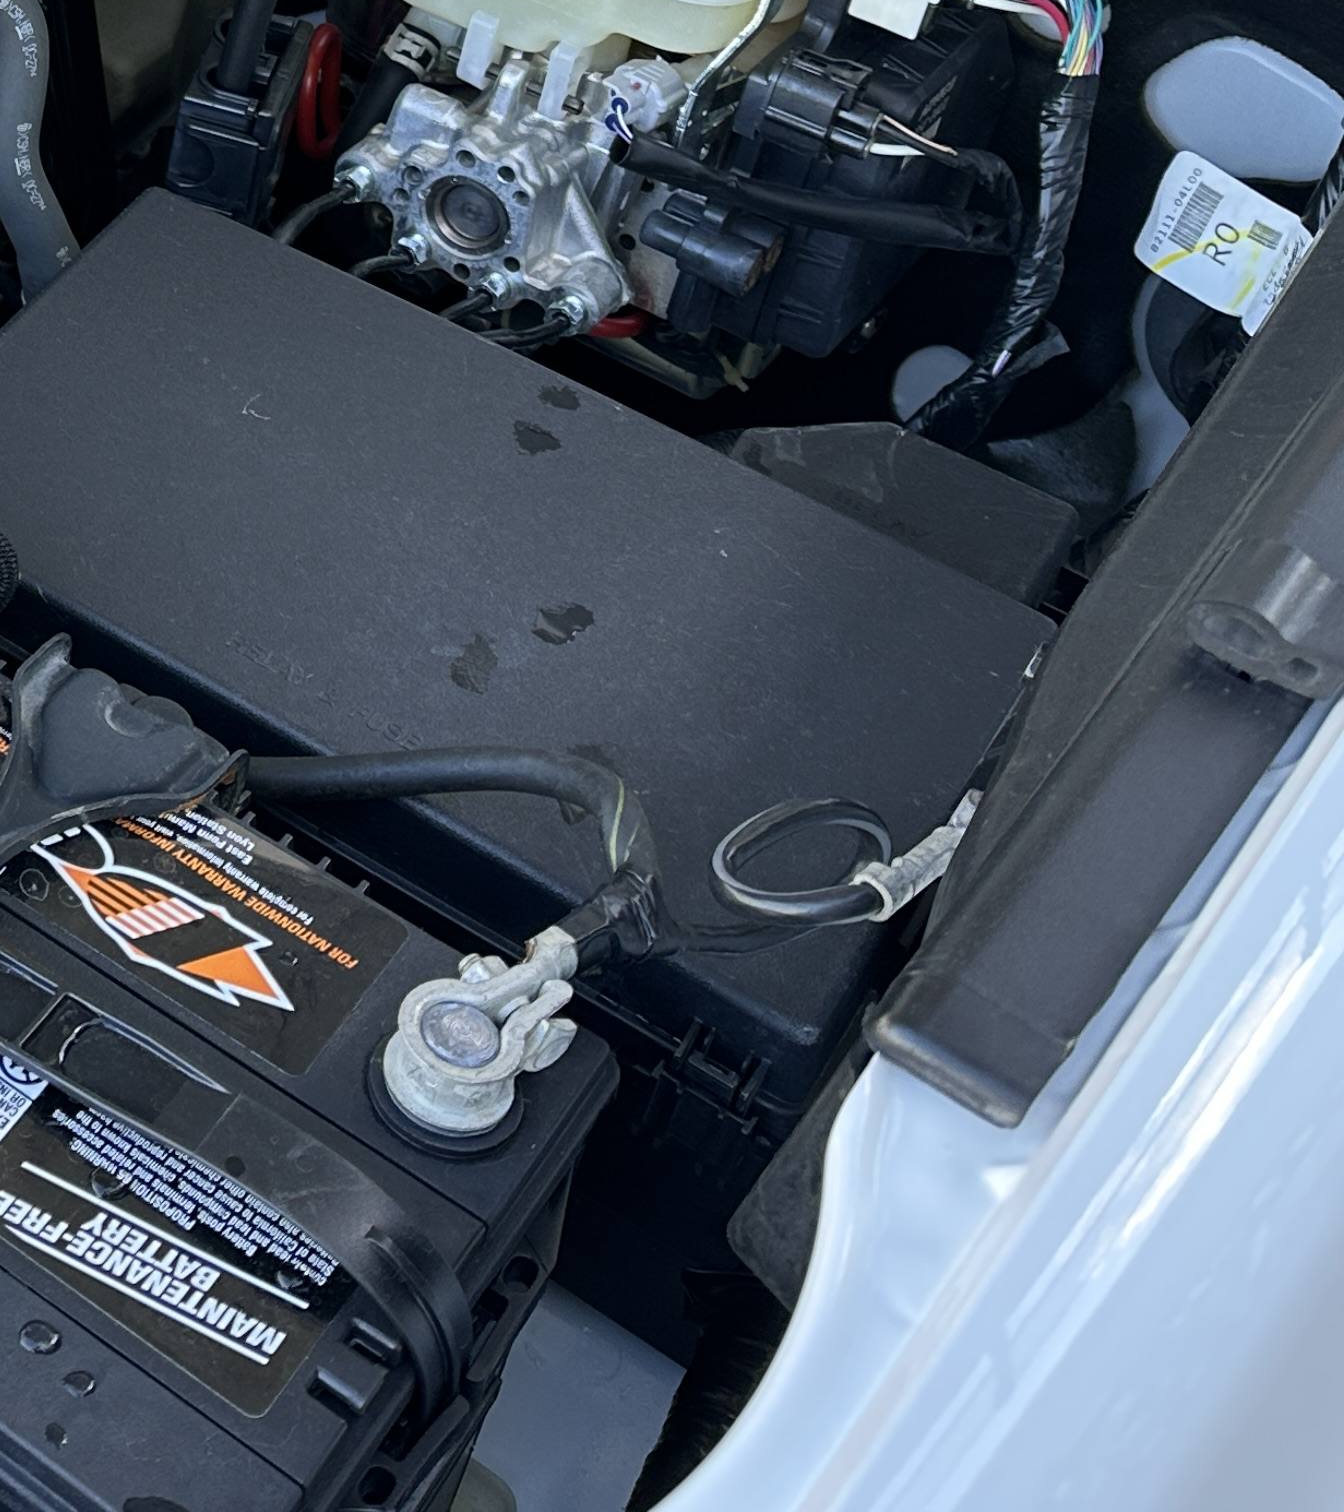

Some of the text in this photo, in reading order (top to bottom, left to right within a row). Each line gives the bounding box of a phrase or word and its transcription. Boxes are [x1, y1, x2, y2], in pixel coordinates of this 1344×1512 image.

[195, 828, 226, 848] Penn
[225, 828, 255, 851] Lyon
[224, 843, 253, 865] East
[171, 848, 247, 901] WARRANTY
[221, 860, 259, 891] warranty
[257, 887, 300, 915] complete
[243, 894, 332, 953] NATIONWIDE
[295, 909, 314, 925] For
[327, 946, 359, 969] FOR
[10, 1092, 26, 1107] OR
[50, 1108, 105, 1149] accessories
[75, 1109, 93, 1127] the
[89, 1118, 103, 1134] to
[100, 1126, 131, 1153] known
[110, 1120, 168, 1160] reproductive
[100, 1143, 136, 1172] related
[128, 1146, 177, 1183] chemicals
[164, 1155, 185, 1174] and
[132, 1165, 153, 1184] and
[182, 1167, 216, 1194] cancer
[150, 1177, 196, 1215] terminals
[212, 1187, 244, 1213] cause
[219, 1176, 246, 1199] other
[128, 1178, 196, 1230] PROPOSITION
[240, 1207, 253, 1220] to
[243, 1193, 281, 1222] contain
[227, 1214, 252, 1236] lead
[248, 1228, 271, 1247] and
[250, 1214, 299, 1252] California
[80, 1210, 221, 1292] BATTERY
[220, 1225, 257, 1256] Battery
[266, 1241, 292, 1263] lead
[294, 1245, 309, 1258] of
[307, 1252, 335, 1277] State
